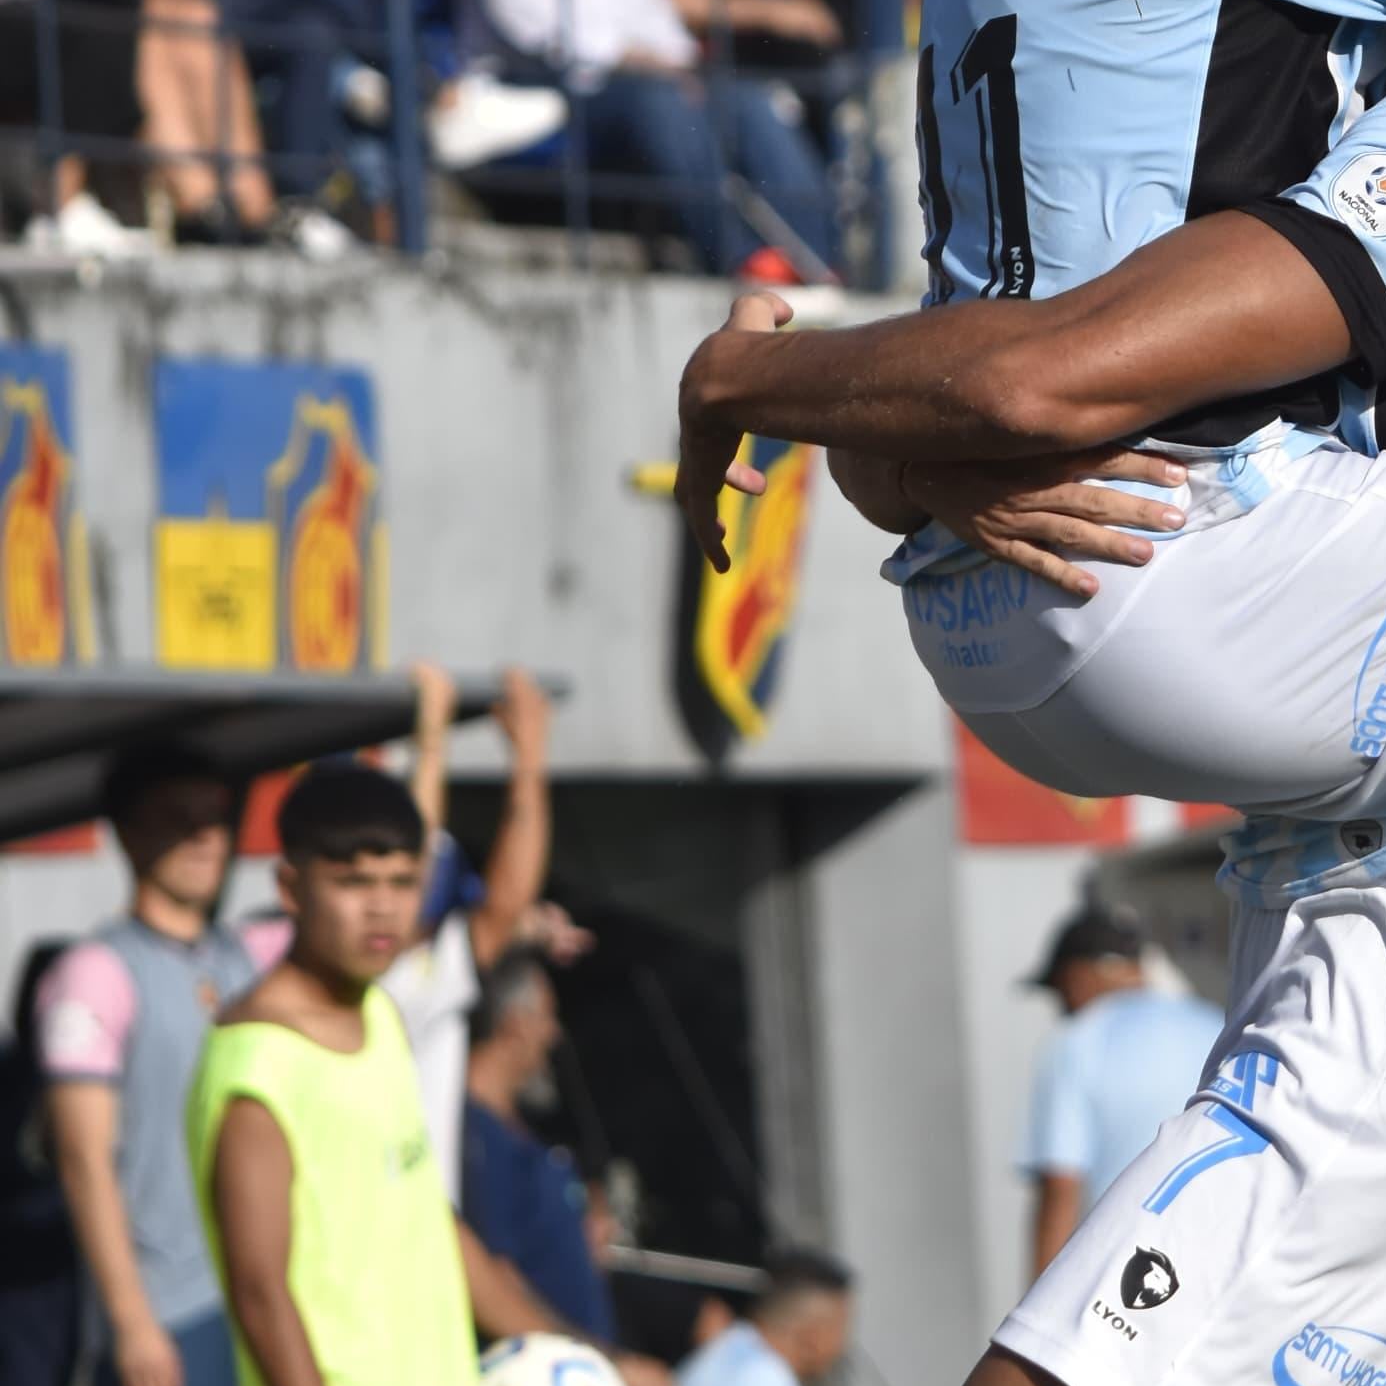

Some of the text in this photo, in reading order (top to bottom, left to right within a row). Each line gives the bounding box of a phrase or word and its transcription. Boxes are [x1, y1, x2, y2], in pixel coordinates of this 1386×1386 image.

[1338, 189, 1379, 232] NACIONAL
[1007, 245, 1025, 295] LYON
[1142, 1101, 1273, 1216] 7
[1091, 1299, 1139, 1342] LYON
